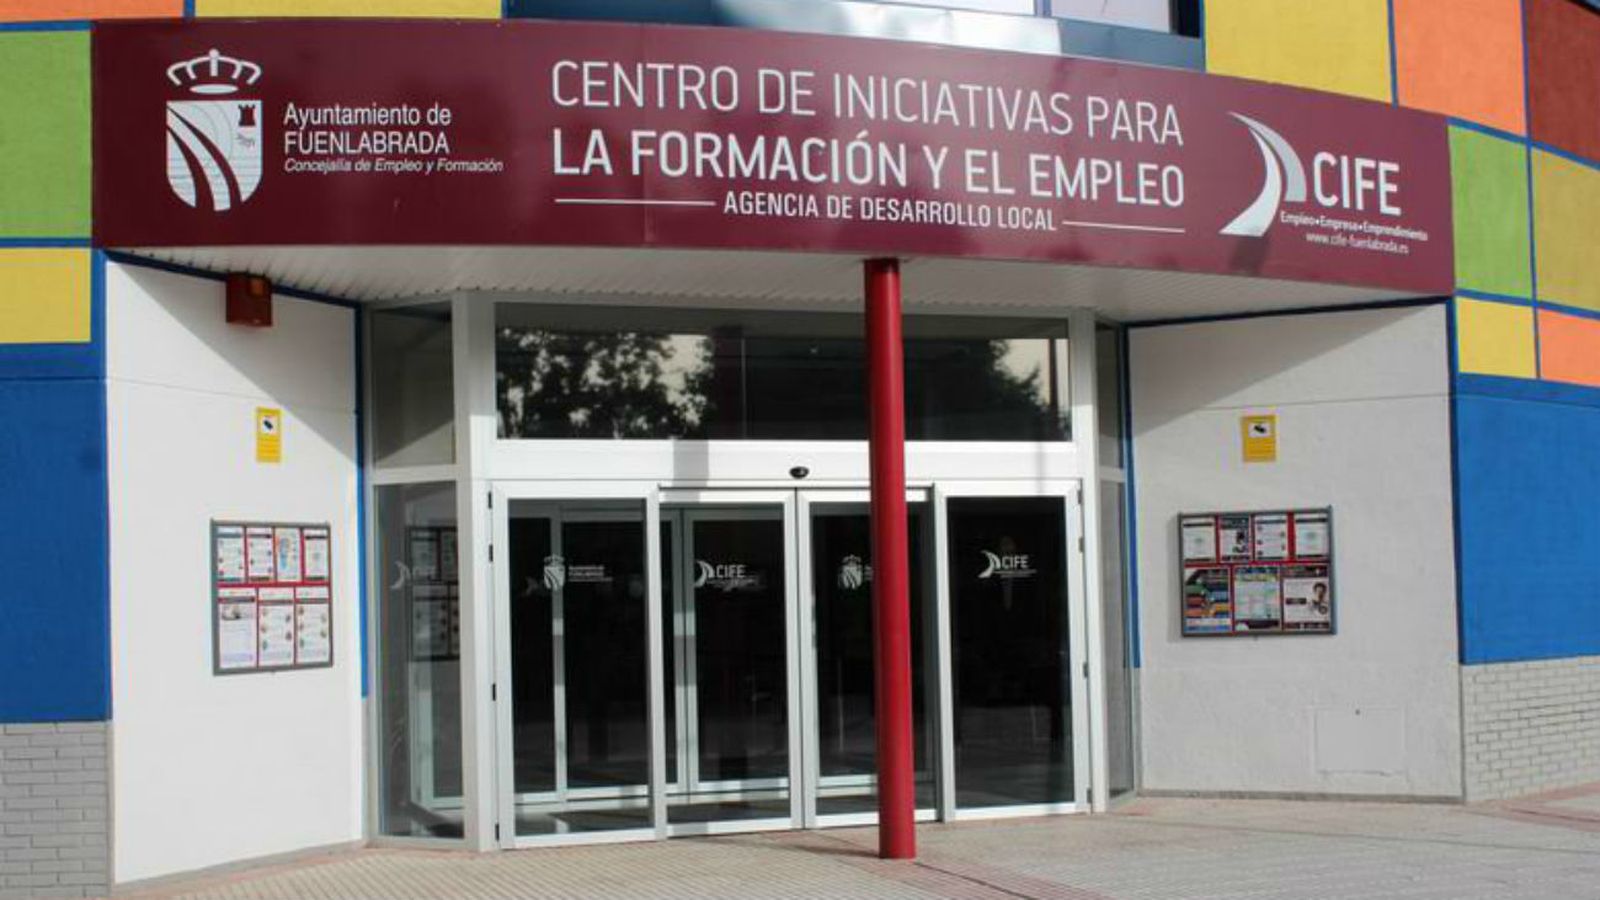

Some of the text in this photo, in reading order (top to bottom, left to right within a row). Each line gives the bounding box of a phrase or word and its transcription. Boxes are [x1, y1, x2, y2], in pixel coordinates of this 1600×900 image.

[283, 102, 452, 129] Ayuntamiento de
[552, 60, 1184, 147] CENTRO DE INICIATIVAS PARA
[284, 131, 450, 154] FUENLABRADA
[354, 158, 371, 172] de
[374, 158, 422, 174] Empleo
[425, 161, 436, 175] y
[437, 158, 504, 172] Formación
[553, 128, 1185, 207] LA FORMACIÓN Y EL EMPLEO
[1313, 151, 1401, 215] CIFE
[723, 190, 1057, 231] AGENCIA DE DESARROLLO LOCAL
[716, 564, 746, 578] CIFE
[1002, 554, 1030, 570] CIFE
